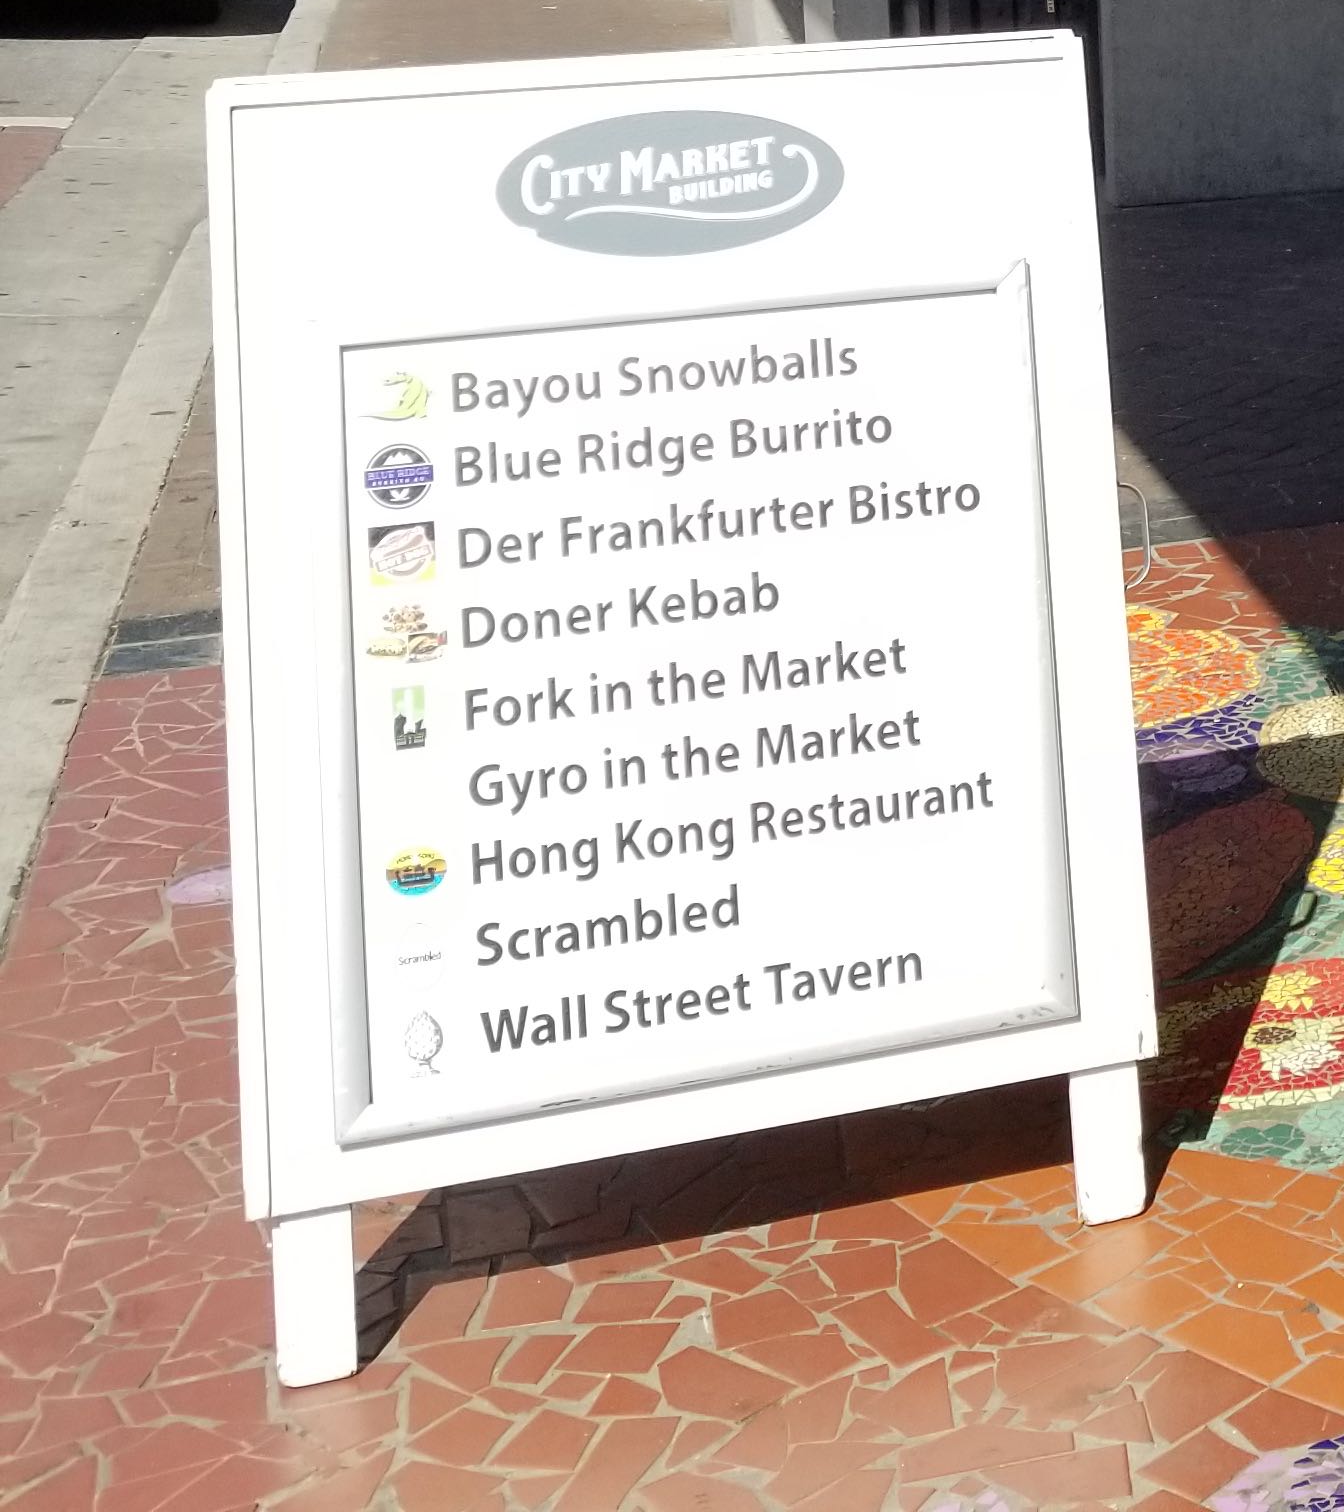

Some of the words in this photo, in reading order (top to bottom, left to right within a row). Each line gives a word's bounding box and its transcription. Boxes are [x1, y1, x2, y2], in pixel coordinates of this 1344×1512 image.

[668, 170, 774, 205] BUILDING
[453, 372, 600, 417] Bayou
[620, 338, 857, 395] Snowballs
[456, 442, 561, 486] Blue
[579, 426, 713, 476] Ridge
[731, 410, 891, 458] Burrito
[459, 528, 543, 568] Der
[562, 498, 833, 556] Frankfurter
[850, 482, 980, 524] Bistro
[463, 602, 612, 648] Doner
[630, 572, 778, 627] Kebab
[466, 678, 575, 730] Fork
[591, 672, 631, 713] in
[648, 662, 725, 705] the
[744, 639, 906, 693] Market
[469, 764, 587, 815] Gyro
[605, 747, 645, 788] in
[662, 736, 739, 780] the
[758, 710, 920, 767] Market
[472, 838, 598, 884] Hong
[616, 818, 733, 862] Kong
[751, 772, 993, 842] Restaurant
[477, 884, 739, 966] Scrambled
[480, 994, 587, 1053] Wall
[605, 974, 751, 1033] Street
[764, 953, 922, 1004] Tavern
